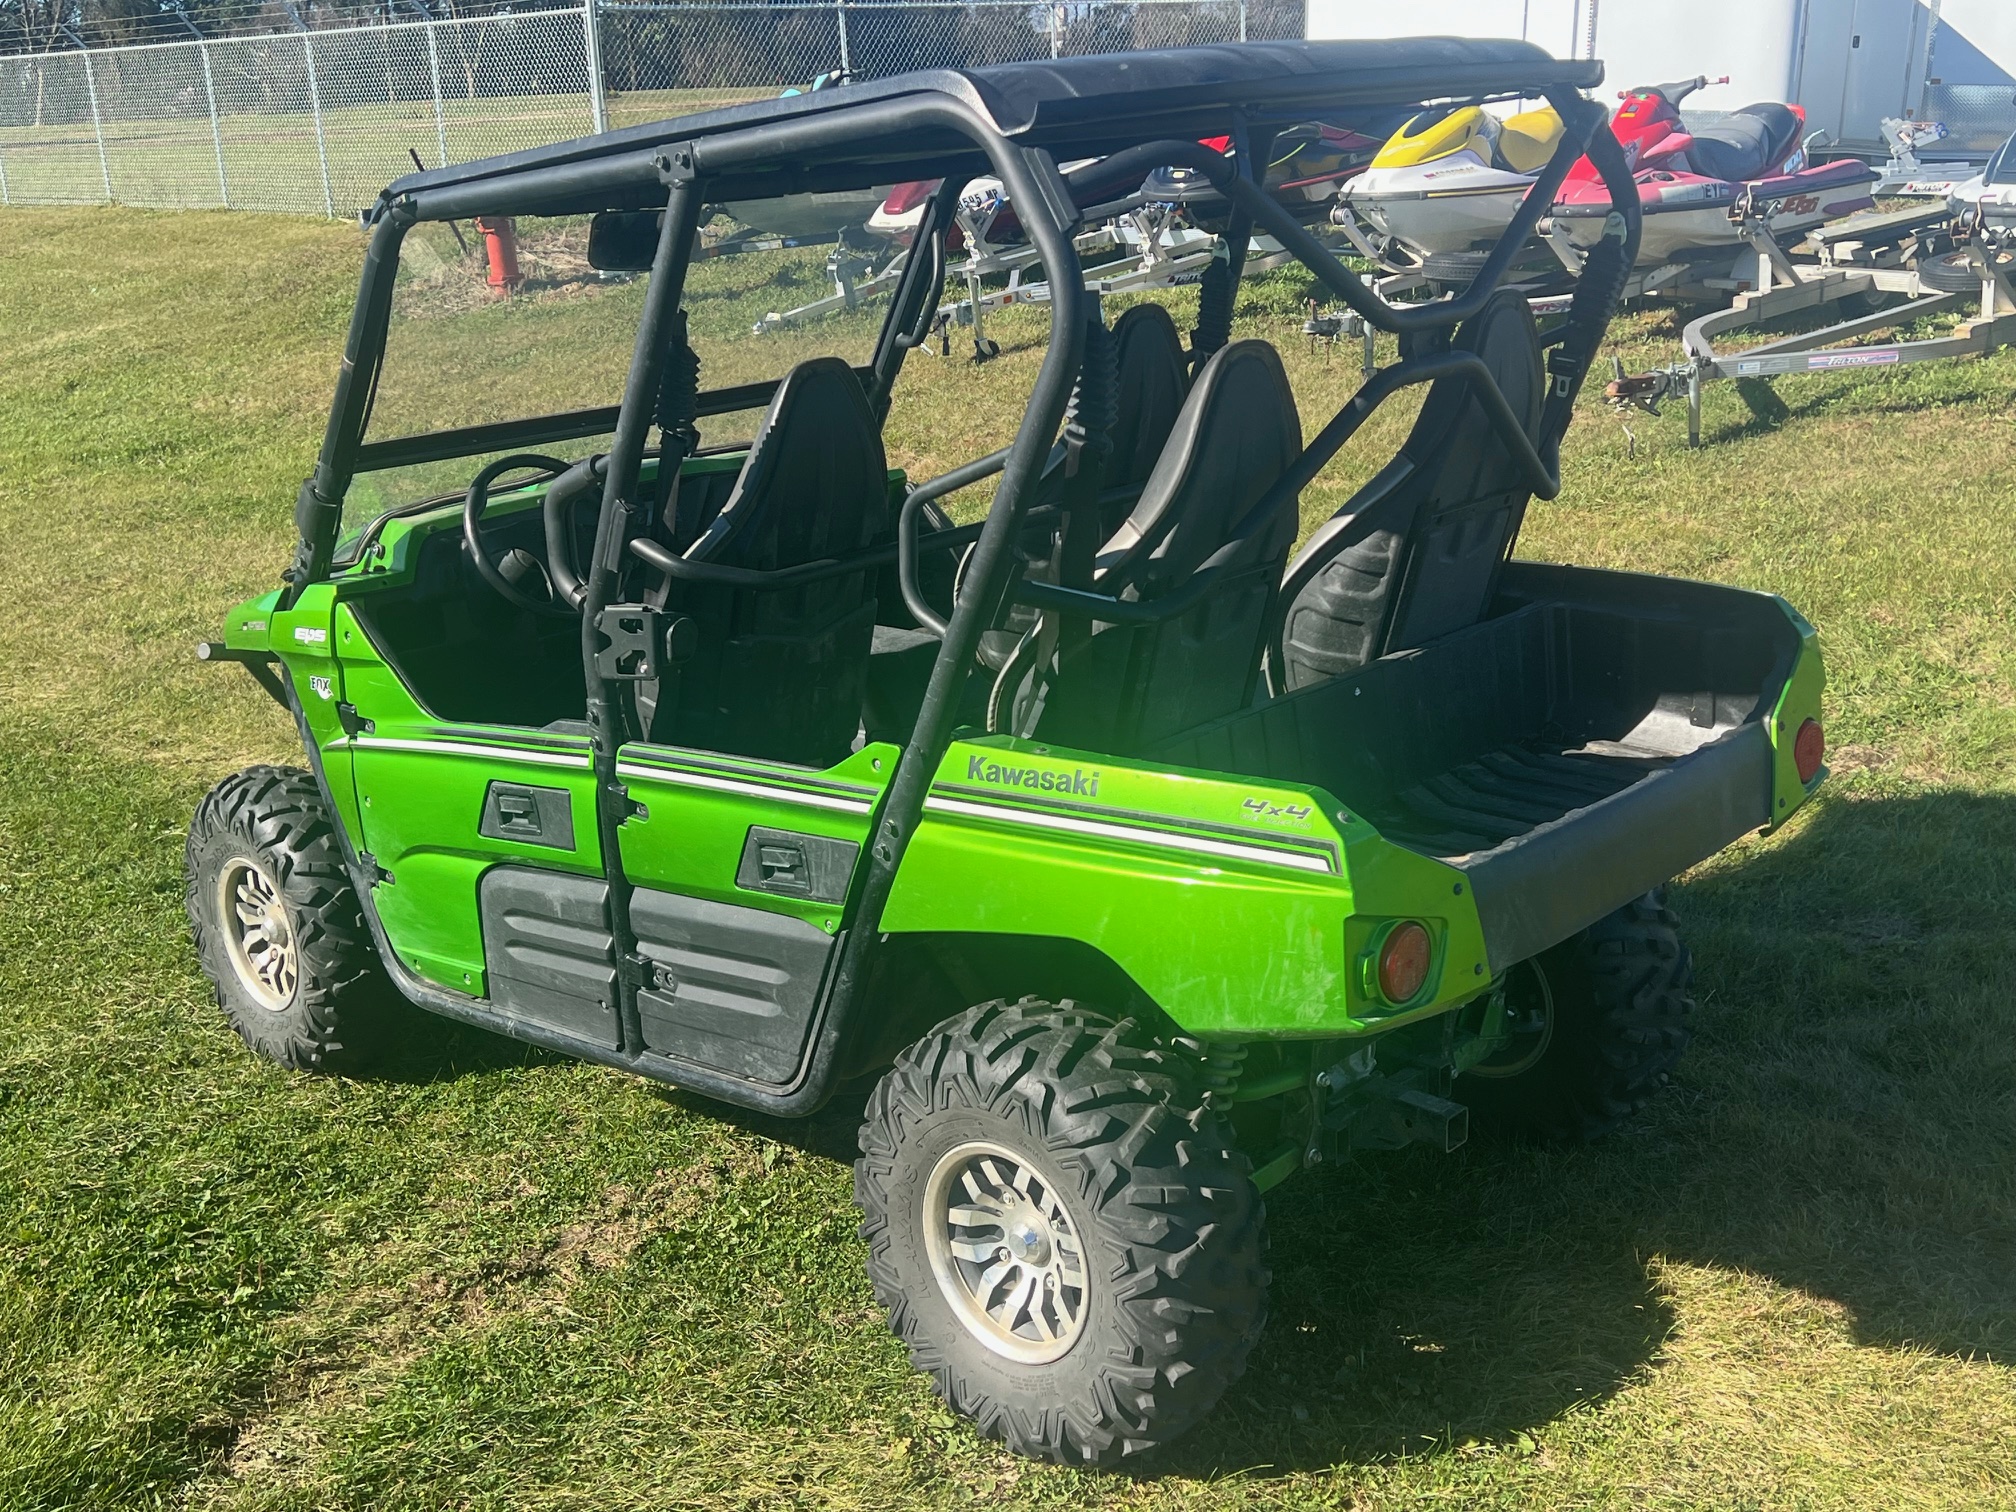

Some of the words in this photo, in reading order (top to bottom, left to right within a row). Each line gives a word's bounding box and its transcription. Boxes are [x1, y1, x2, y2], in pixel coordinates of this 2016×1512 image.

[1827, 355, 1869, 366] TRITON
[310, 676, 330, 691] FOX
[967, 755, 1100, 798] Kawasaki
[1243, 799, 1312, 819] 4x4
